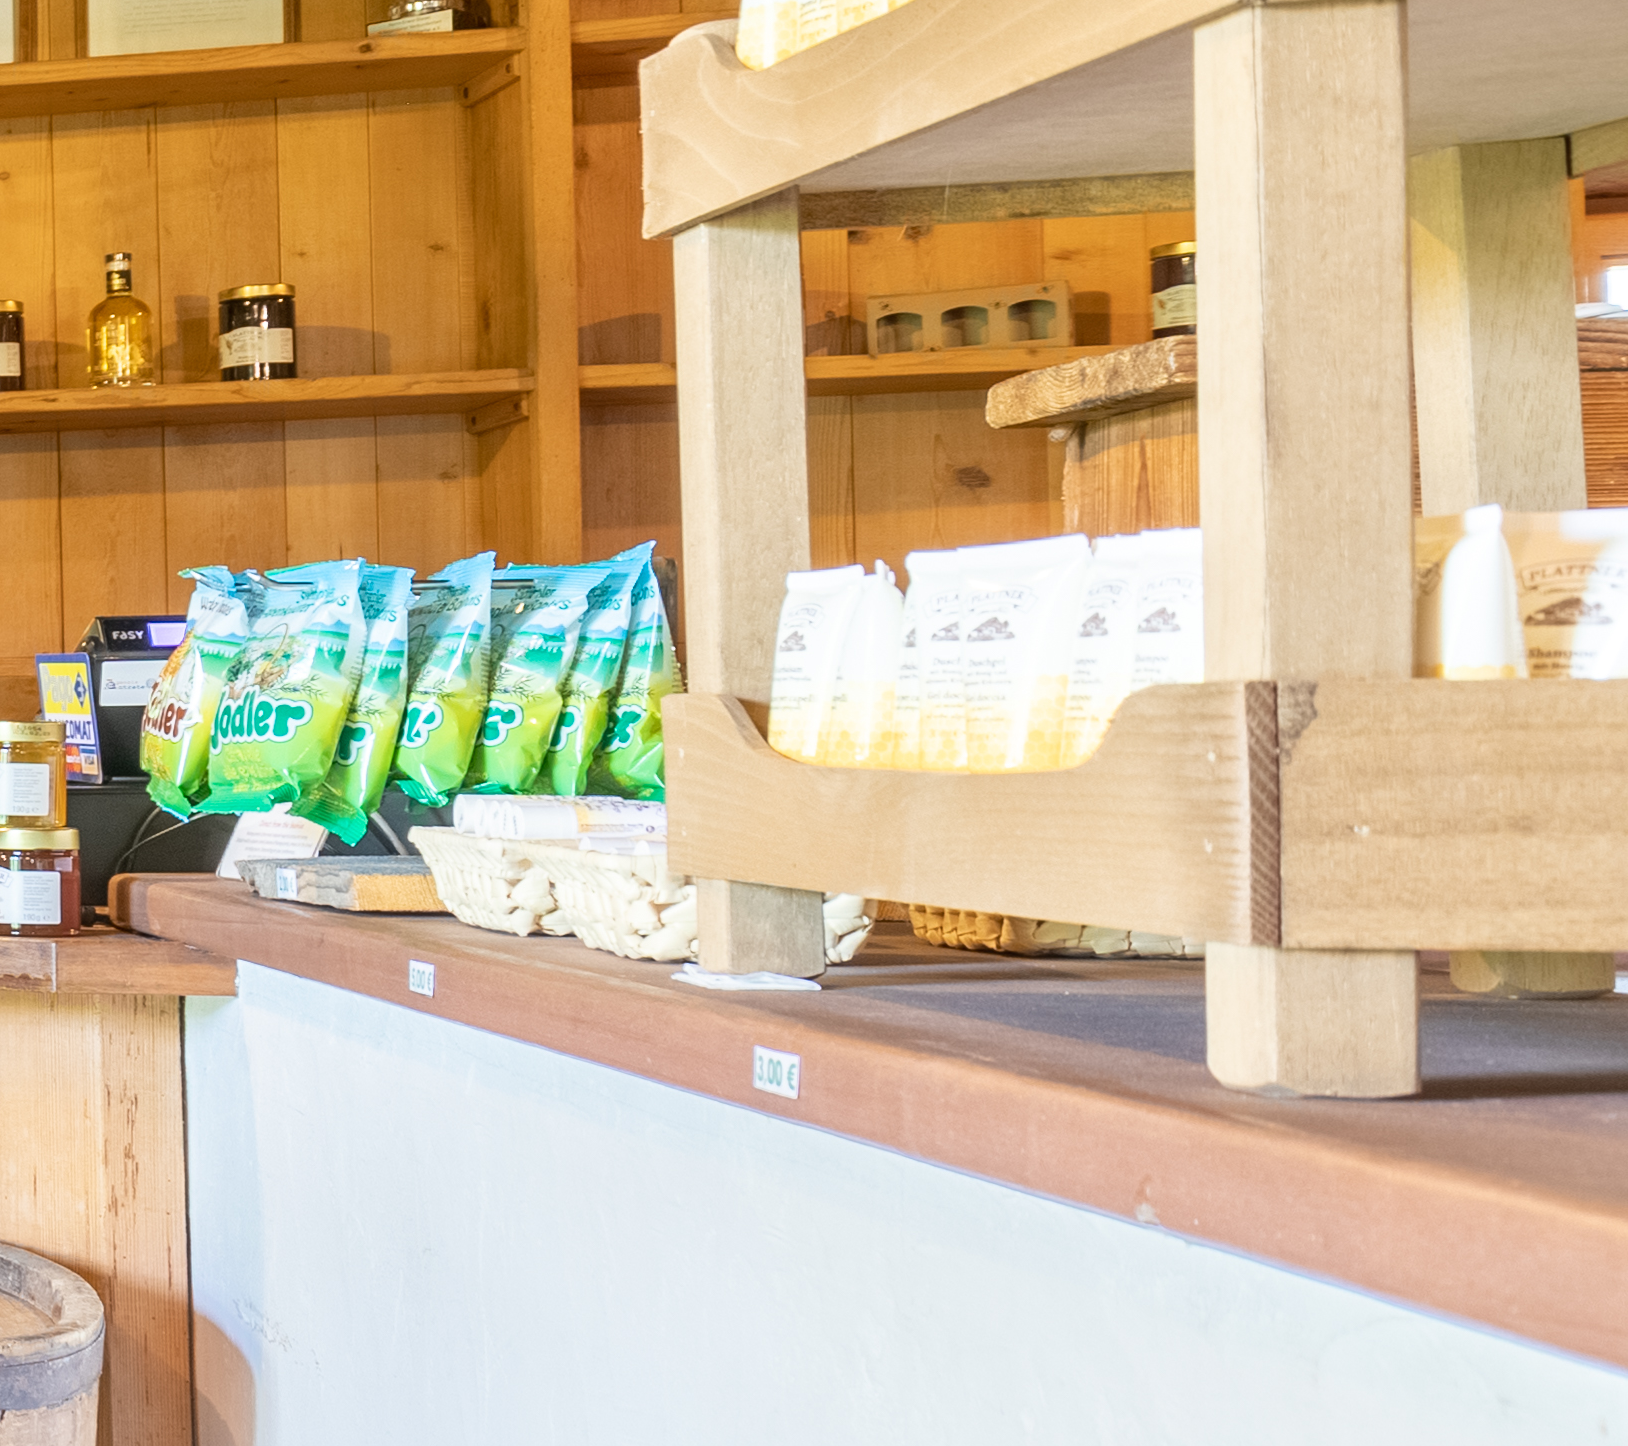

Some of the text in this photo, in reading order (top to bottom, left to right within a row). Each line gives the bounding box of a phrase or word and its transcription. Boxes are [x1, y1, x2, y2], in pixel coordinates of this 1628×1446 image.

[972, 590, 1025, 603] PLATTNER
[112, 631, 145, 640] FASY
[211, 687, 305, 750] Jodler
[758, 1055, 796, 1091] 3,00 €
